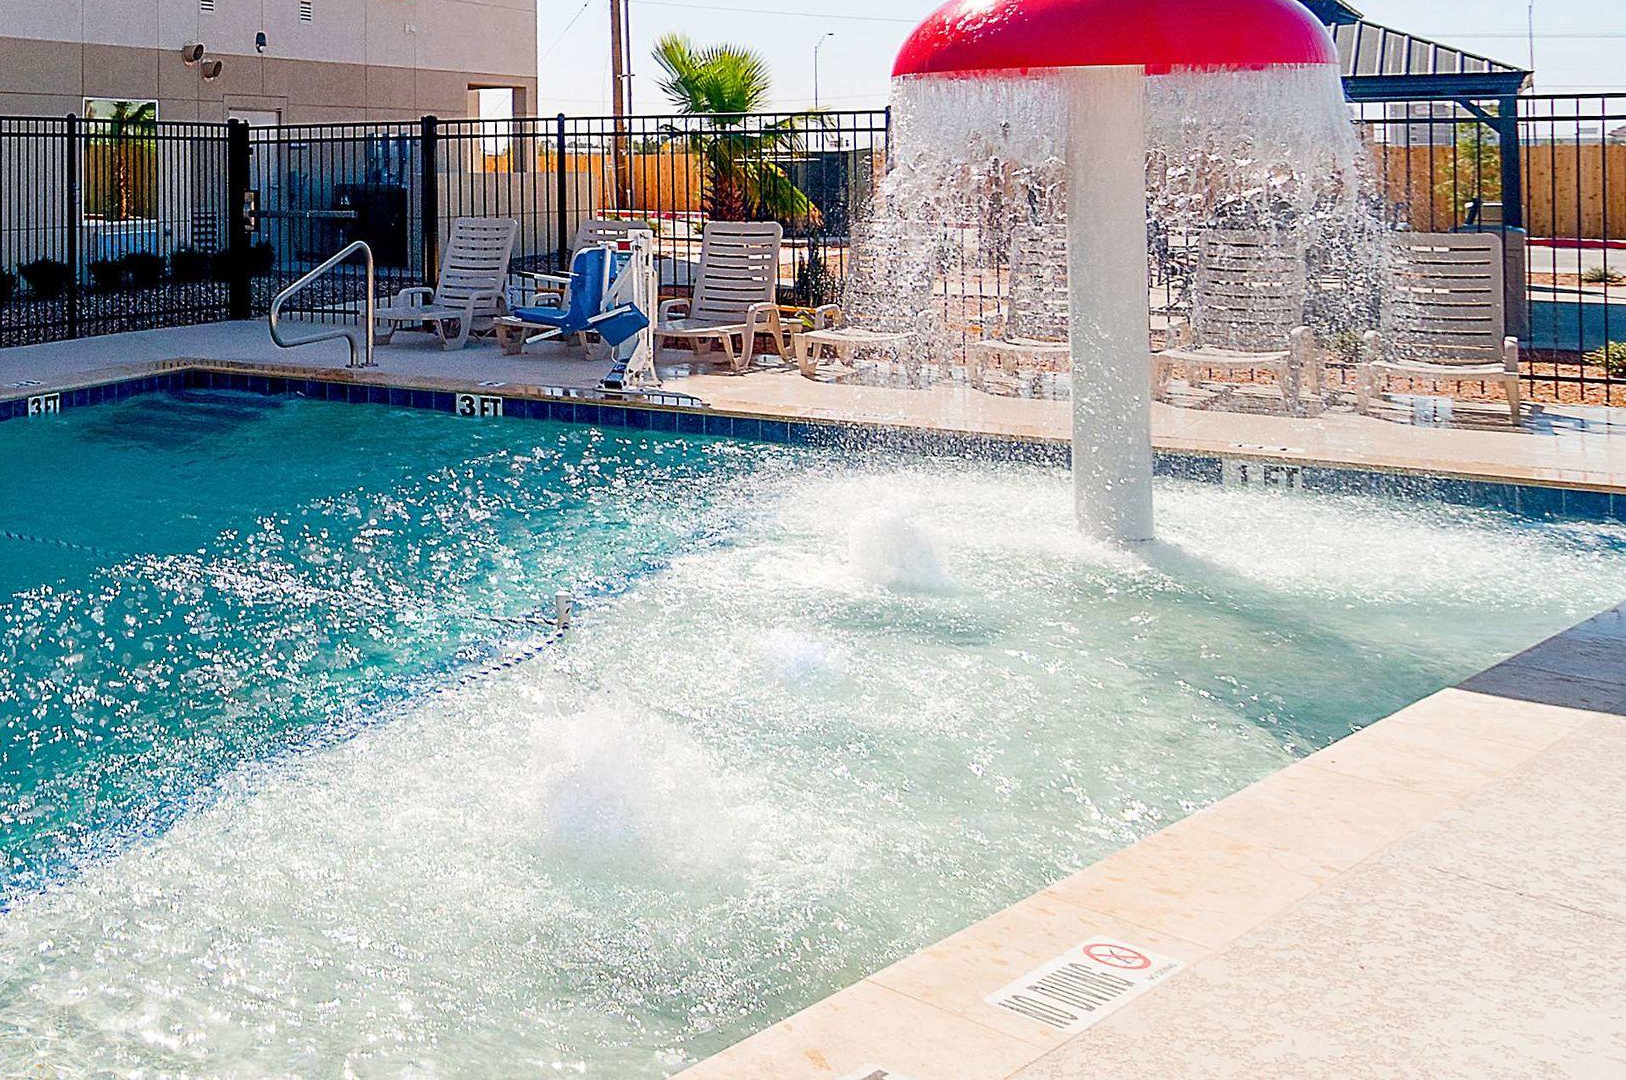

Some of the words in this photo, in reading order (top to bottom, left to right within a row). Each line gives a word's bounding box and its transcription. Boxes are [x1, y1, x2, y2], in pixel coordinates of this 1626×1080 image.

[31, 397, 42, 415] 3
[44, 394, 59, 414] FT
[460, 395, 476, 417] 3
[480, 397, 502, 417] FT
[1026, 962, 1136, 1012] DIVING
[997, 994, 1079, 1029] NO
